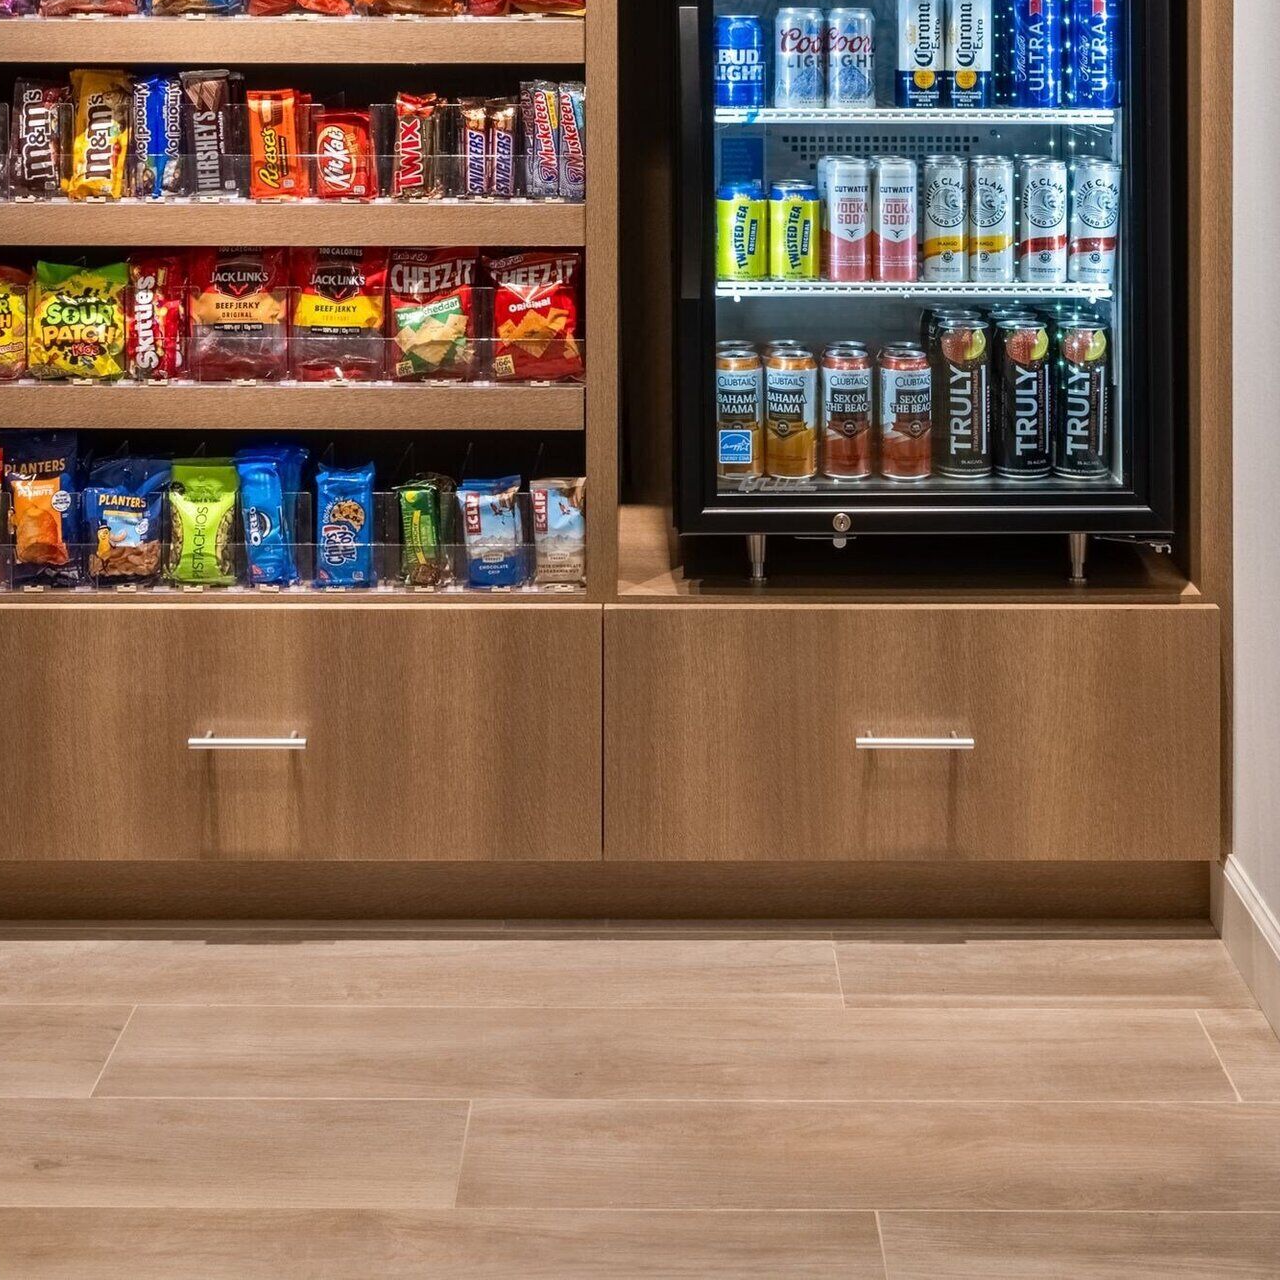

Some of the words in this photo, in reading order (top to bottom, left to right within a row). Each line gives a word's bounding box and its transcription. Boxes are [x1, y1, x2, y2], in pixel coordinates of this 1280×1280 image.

[913, 3, 931, 67] Corona
[932, 18, 941, 50] Extra
[956, 2, 972, 67] Corona
[973, 18, 983, 50] Extra
[719, 49, 759, 64] BUD
[1029, 22, 1045, 91] ULTRA
[1091, 20, 1107, 91] ULTRA
[714, 65, 763, 81] LIGHT
[193, 110, 220, 195] HERSHEY'S
[468, 130, 485, 195] SNICKERS
[494, 131, 512, 195] SNICKERS
[978, 177, 1004, 194] CLAW
[740, 205, 749, 224] TEA
[792, 205, 802, 224] TEA
[837, 215, 866, 225] SODA
[734, 225, 748, 269] TWISTED
[786, 225, 801, 269] TWISTED
[210, 272, 235, 283] JACK
[236, 272, 269, 283] LINK'S
[46, 304, 115, 323] SOUR
[233, 302, 260, 310] JERKY
[314, 304, 332, 313] BEEF
[333, 304, 357, 313] JERKY
[43, 323, 117, 346] PATCH
[718, 376, 757, 387] CLUBTAILS
[830, 376, 869, 387] CLUBTAILS
[717, 393, 757, 404] BAHAMA
[833, 393, 849, 403] SEX
[850, 393, 866, 402] ON
[900, 395, 914, 404] SEX
[915, 394, 928, 403] ON
[721, 404, 754, 414] MAMA
[770, 403, 800, 413] MAMA
[950, 364, 972, 455] TRULY
[1015, 364, 1038, 456] TRULY
[1066, 365, 1091, 456] TRULY
[4, 458, 66, 475] PLANTERS
[99, 494, 146, 508] PLANTERS
[250, 506, 262, 547] OREO
[193, 506, 209, 580] PISTACHIOS
